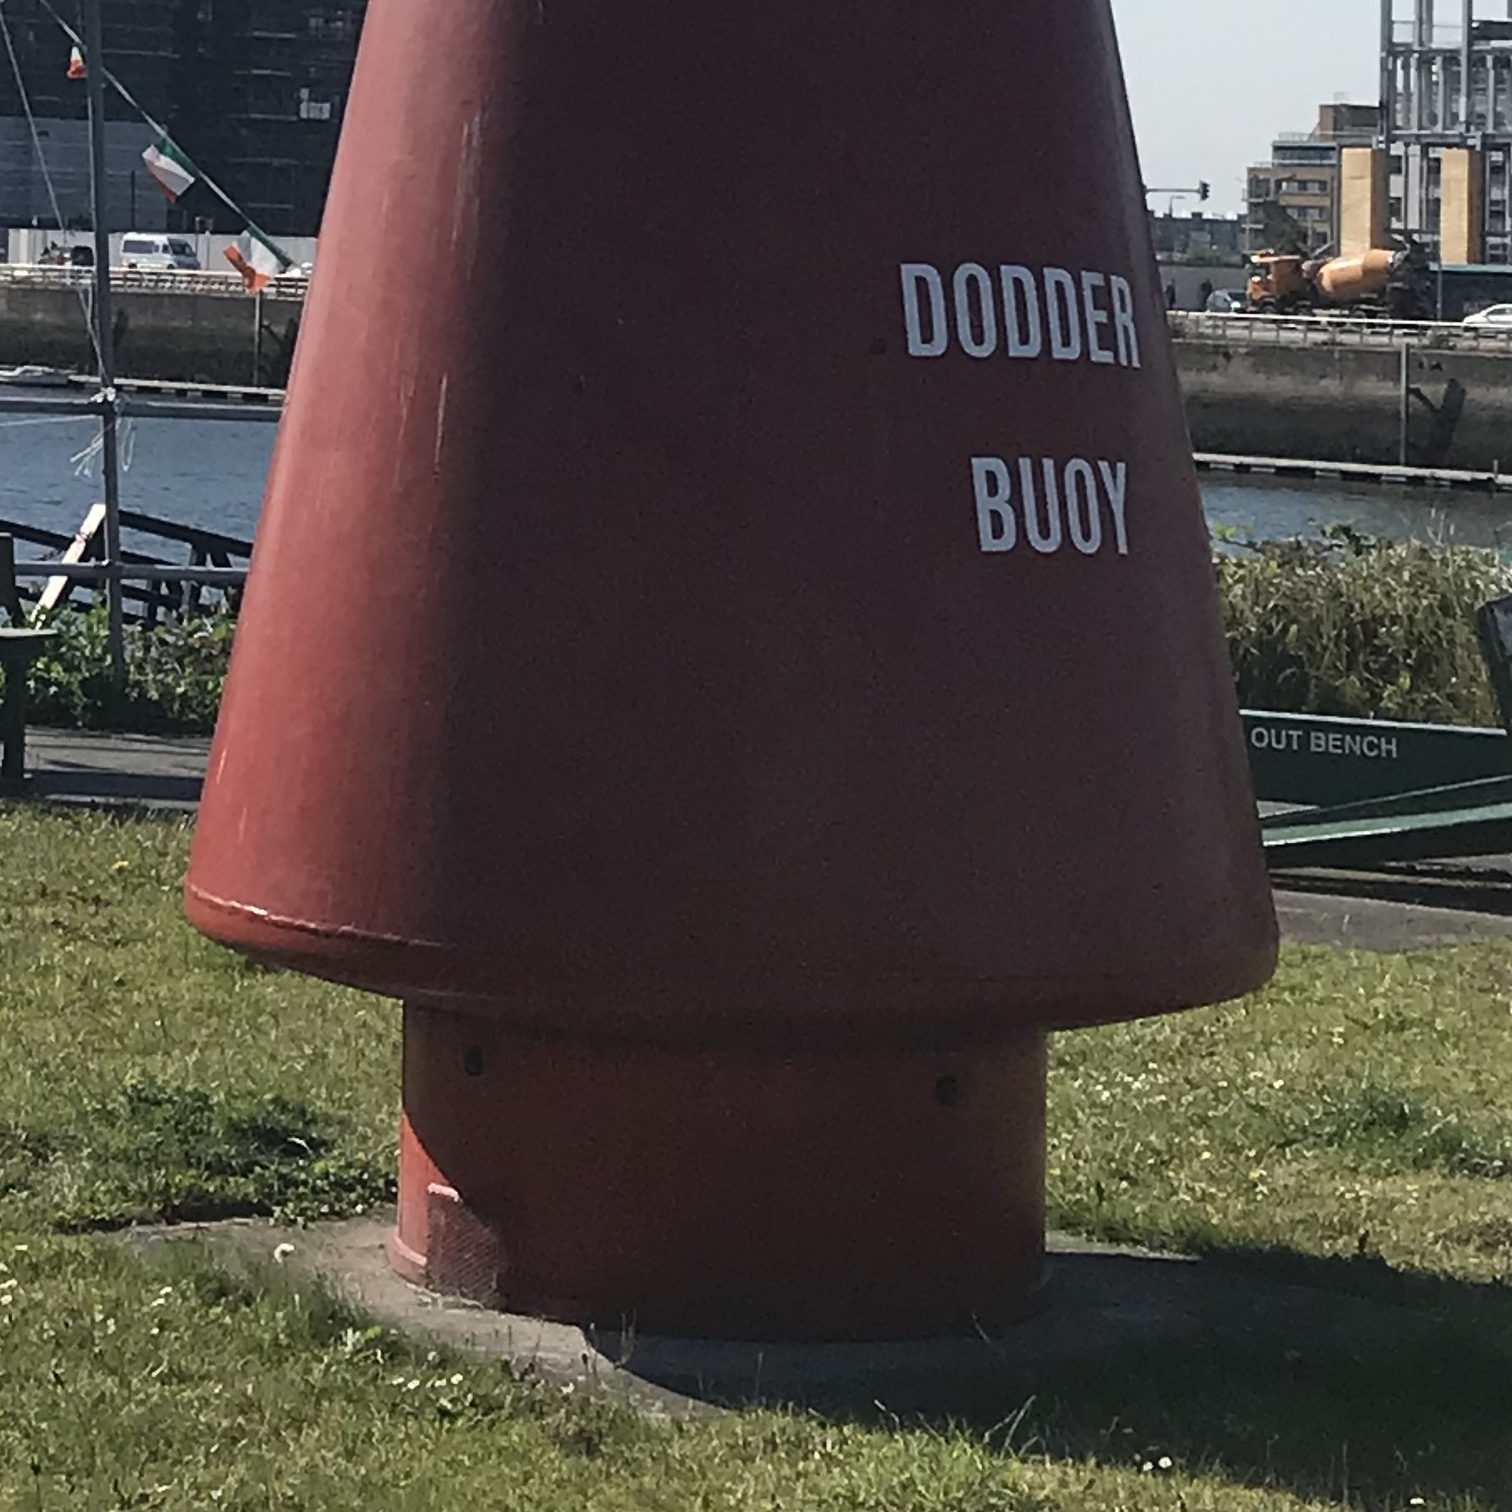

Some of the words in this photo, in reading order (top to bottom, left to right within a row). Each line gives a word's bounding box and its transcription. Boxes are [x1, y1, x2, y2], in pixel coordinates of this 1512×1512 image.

[900, 262, 1141, 368] DODDER
[971, 457, 1128, 556] BUOY
[1250, 726, 1303, 750] OUT
[1309, 732, 1398, 758] BENCH
